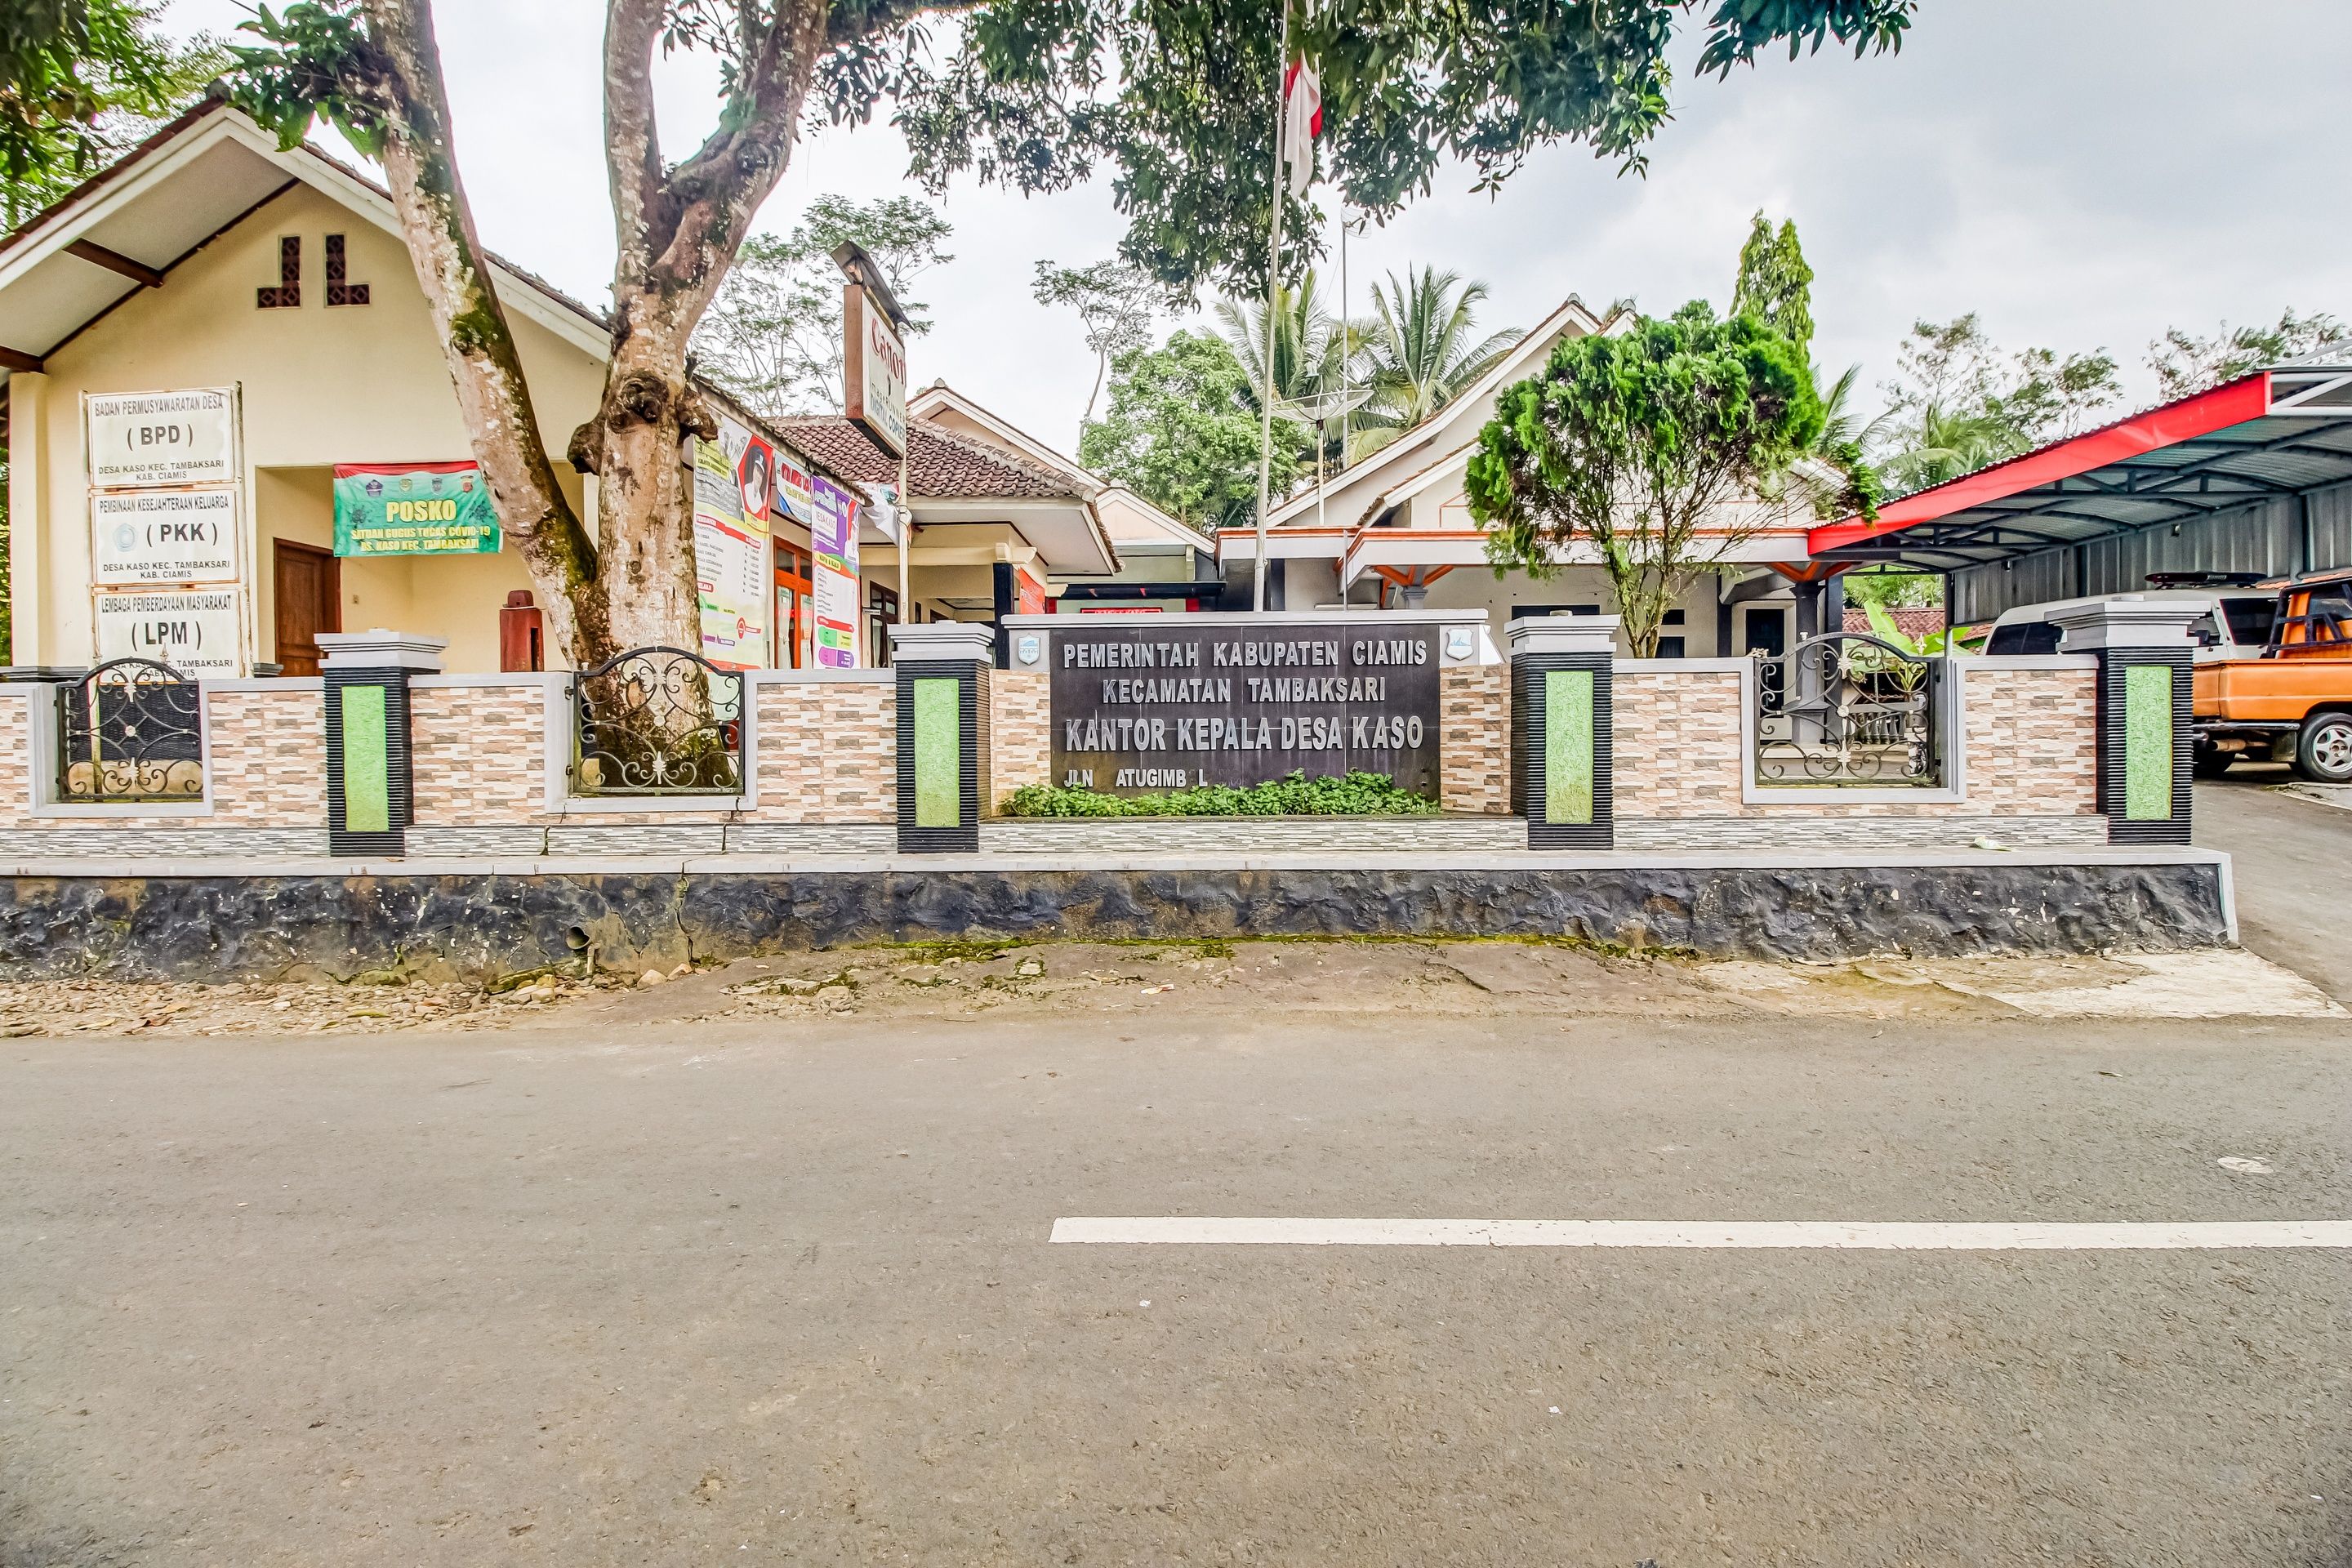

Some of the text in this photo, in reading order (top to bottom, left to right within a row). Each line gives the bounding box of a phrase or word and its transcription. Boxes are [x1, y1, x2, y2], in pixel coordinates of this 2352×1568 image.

[871, 317, 906, 385] Canon
[95, 395, 223, 416] BADAN PERMUSYAWARATAN DESA
[99, 460, 224, 474] DESA KASO KEC. TAMBAKSARI
[136, 471, 187, 480] KAB. CIAMIS
[100, 496, 229, 514] PEMBINAAN KESEJAHTERAAN KELUARGA
[385, 499, 457, 523] POSKO
[351, 525, 491, 540] SATUAN GUGUS TUGAS COVID-19
[376, 540, 400, 550] KASO
[423, 538, 479, 550] TAMBAKSARI
[104, 560, 230, 572] DESA KASO KEC. TAMBAKSARI
[163, 570, 192, 578] CIAMIS
[102, 595, 231, 612] LEMBAGA PEMBERDAYAAN MASYARAKAT
[1064, 639, 1427, 669] PEMERINTAH KABUPATEN CIAMIS
[177, 659, 234, 667] TAMBAKSARI
[1102, 676, 1386, 705] KECAMATAN TAMBAKSARI
[1066, 715, 1423, 752] KANTOR KEPALA DESA KASO
